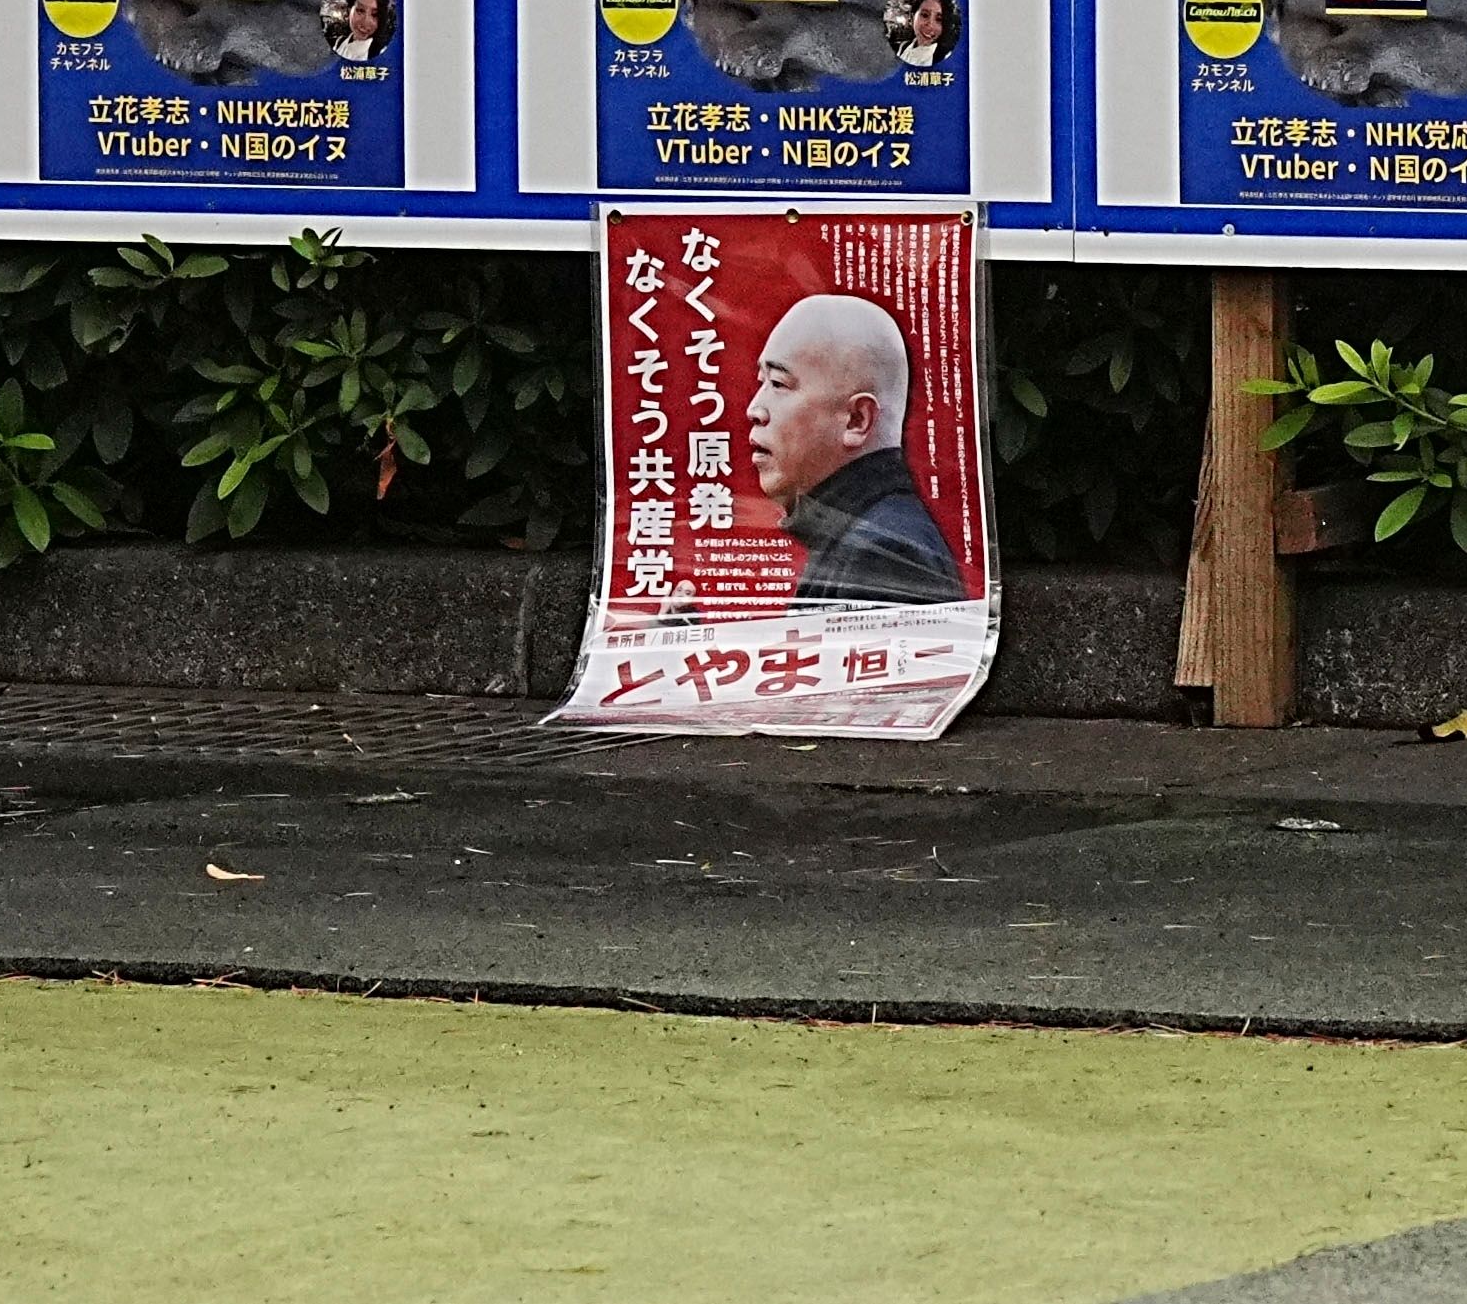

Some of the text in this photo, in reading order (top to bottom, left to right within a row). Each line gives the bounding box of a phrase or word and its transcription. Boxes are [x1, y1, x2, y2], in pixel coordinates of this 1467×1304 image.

[89, 93, 350, 130] 立花孝志・NHK党応援
[626, 248, 675, 599] なくそう共産党
[682, 227, 733, 531] なくそう原発
[599, 629, 822, 707] とやま
